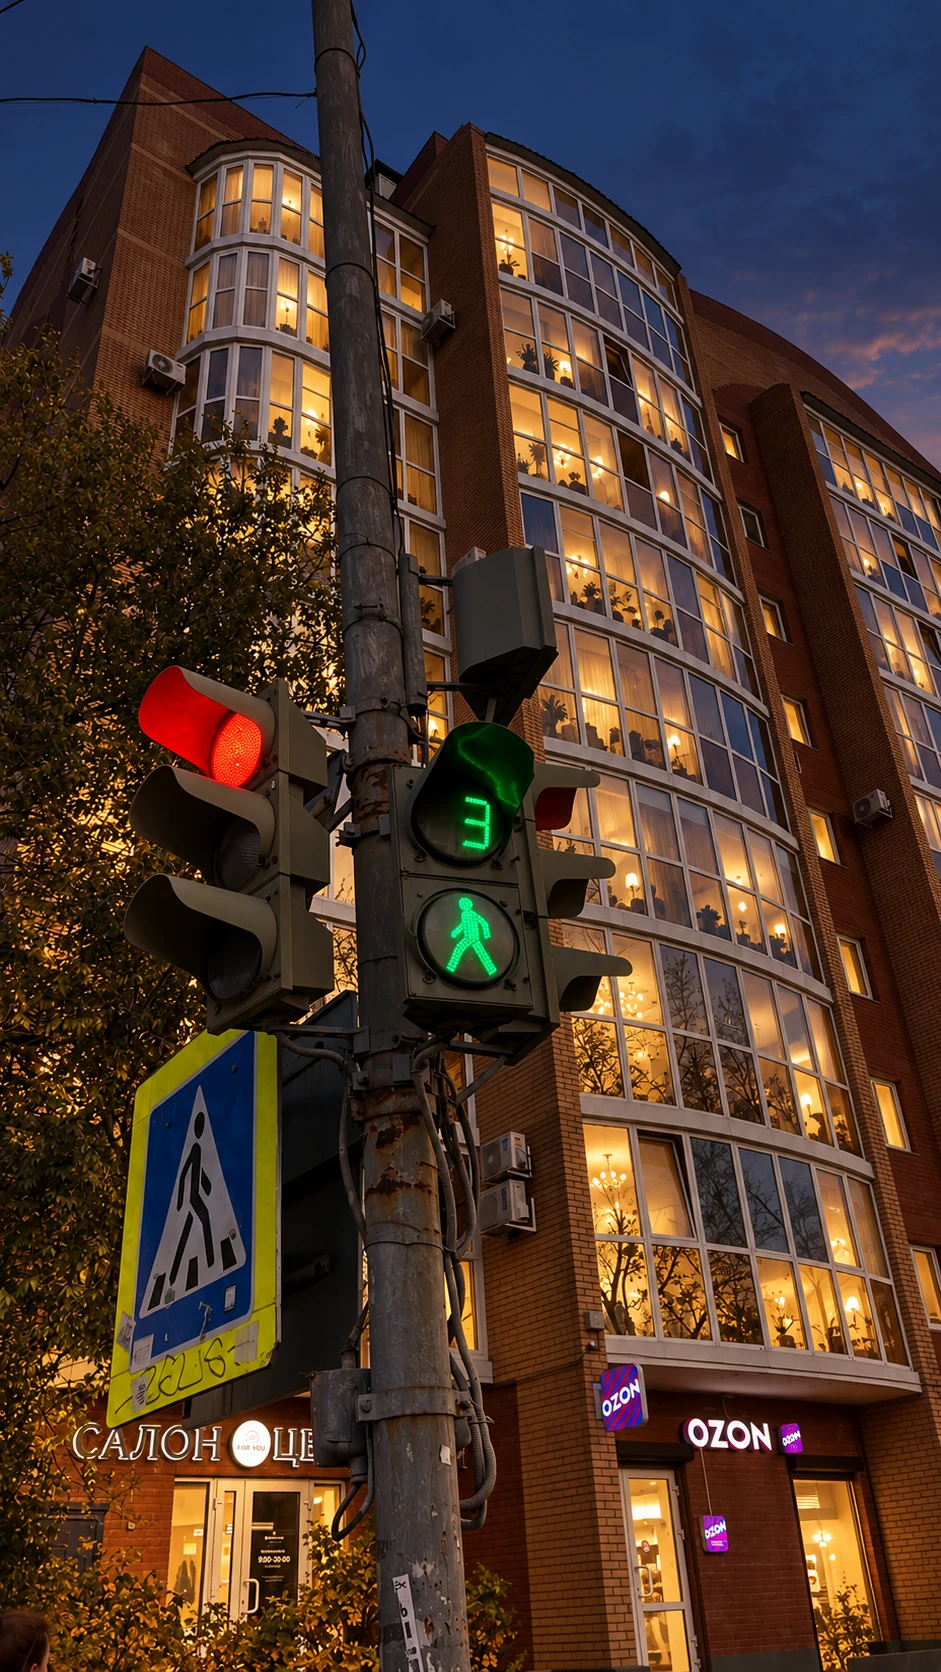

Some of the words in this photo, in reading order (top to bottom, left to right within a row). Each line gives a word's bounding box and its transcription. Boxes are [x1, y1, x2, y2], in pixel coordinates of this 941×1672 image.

[462, 796, 491, 850] 3
[602, 1378, 640, 1417] OZON
[72, 1421, 222, 1462] САЛОН
[686, 1418, 772, 1451] OZON
[782, 1430, 801, 1446] OZON
